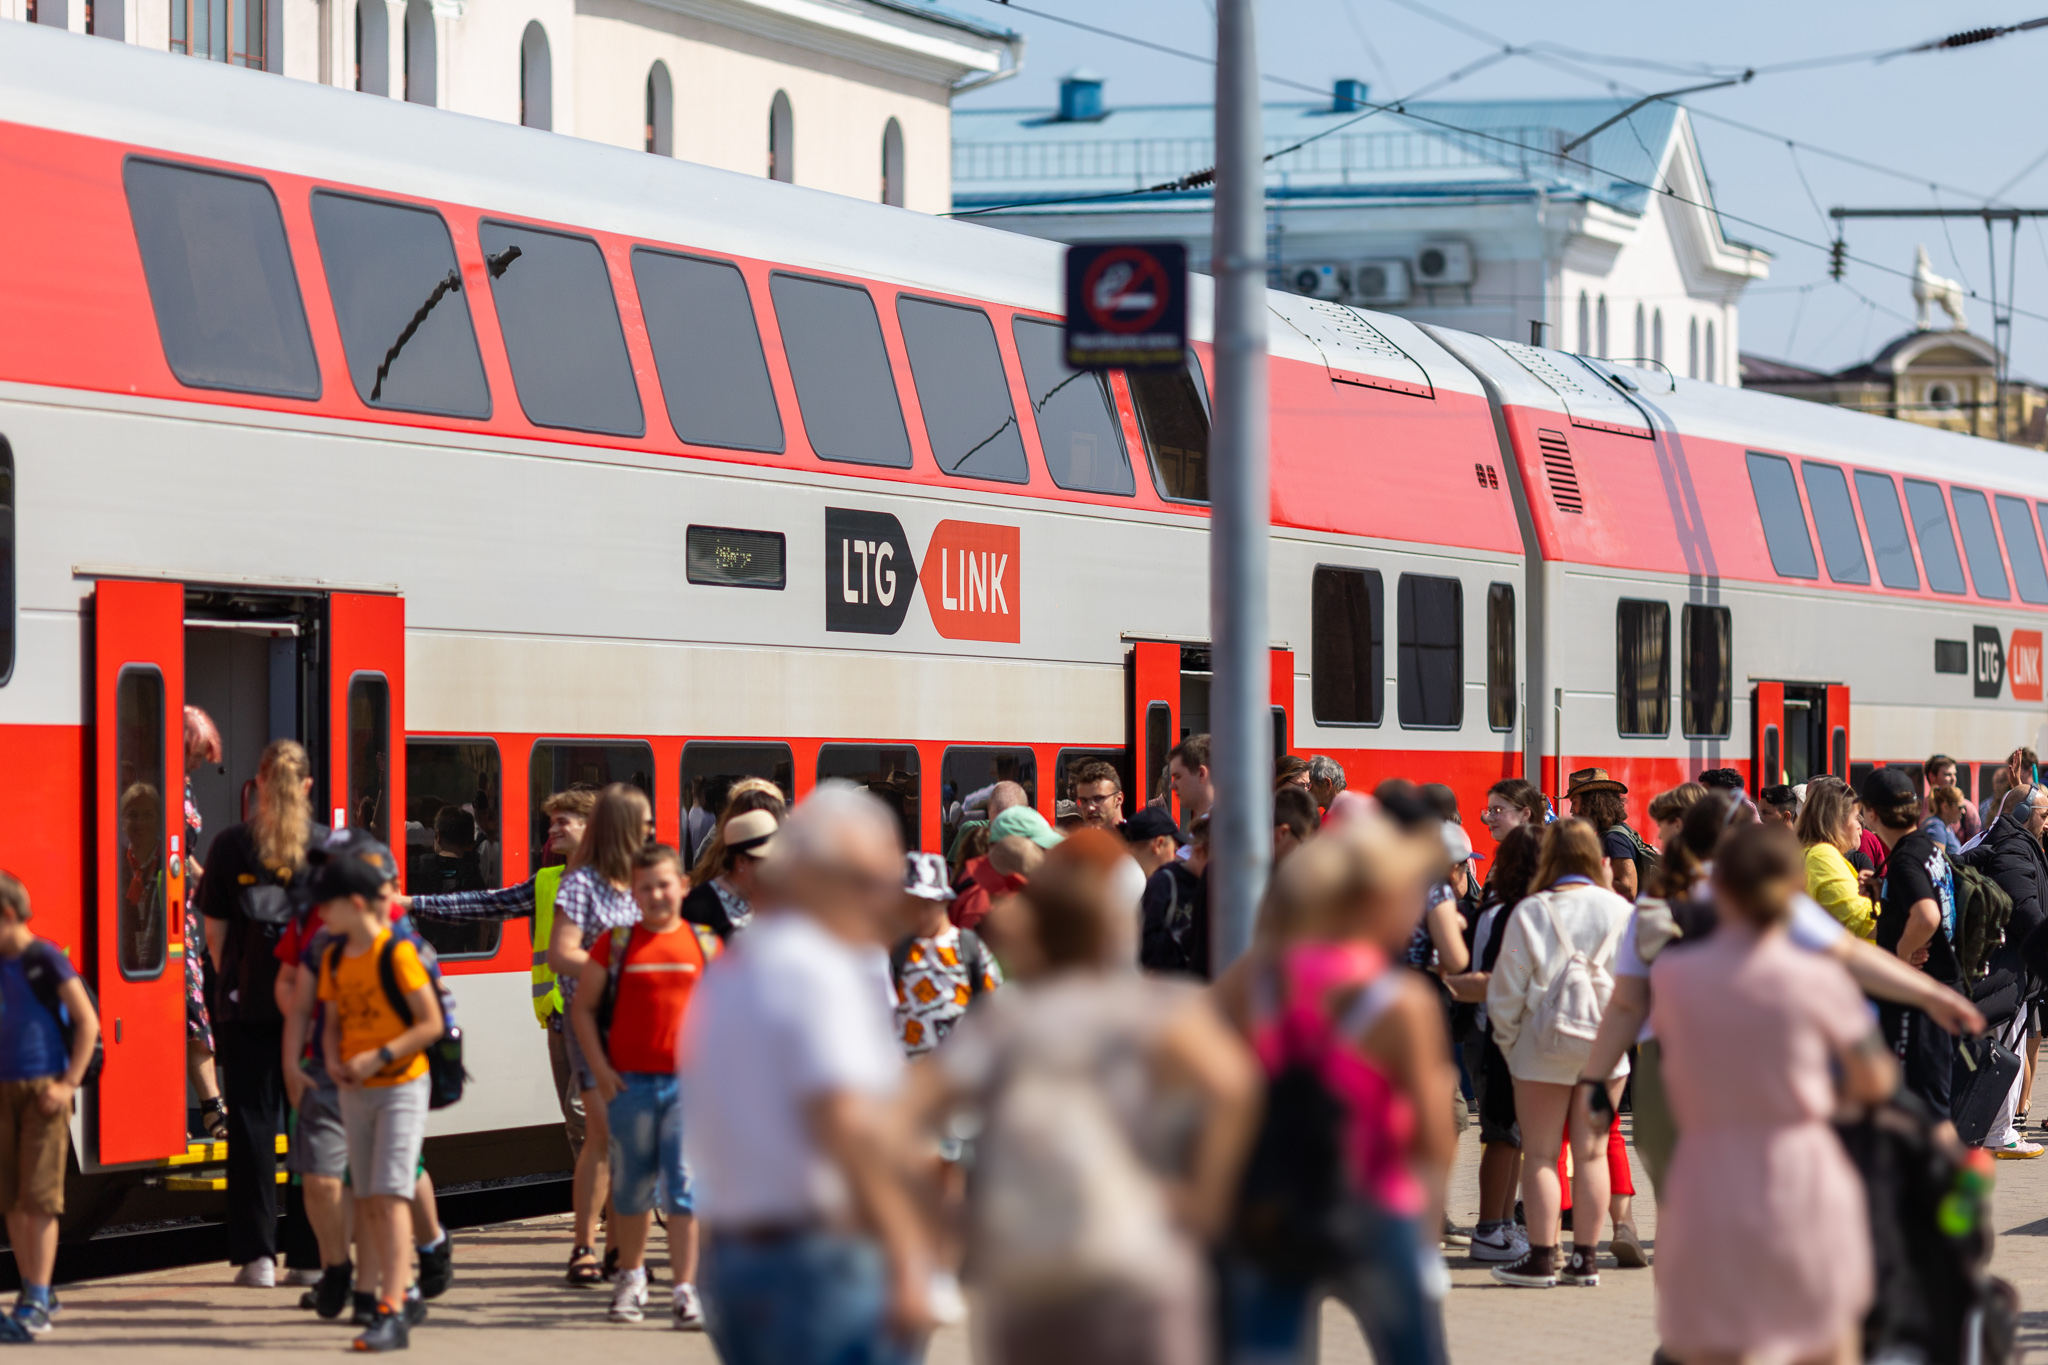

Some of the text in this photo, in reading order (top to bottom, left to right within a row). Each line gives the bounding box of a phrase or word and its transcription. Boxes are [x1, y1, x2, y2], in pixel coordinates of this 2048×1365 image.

[843, 538, 1009, 615] LTG LINK
[1979, 642, 2040, 686] LTG LINK
